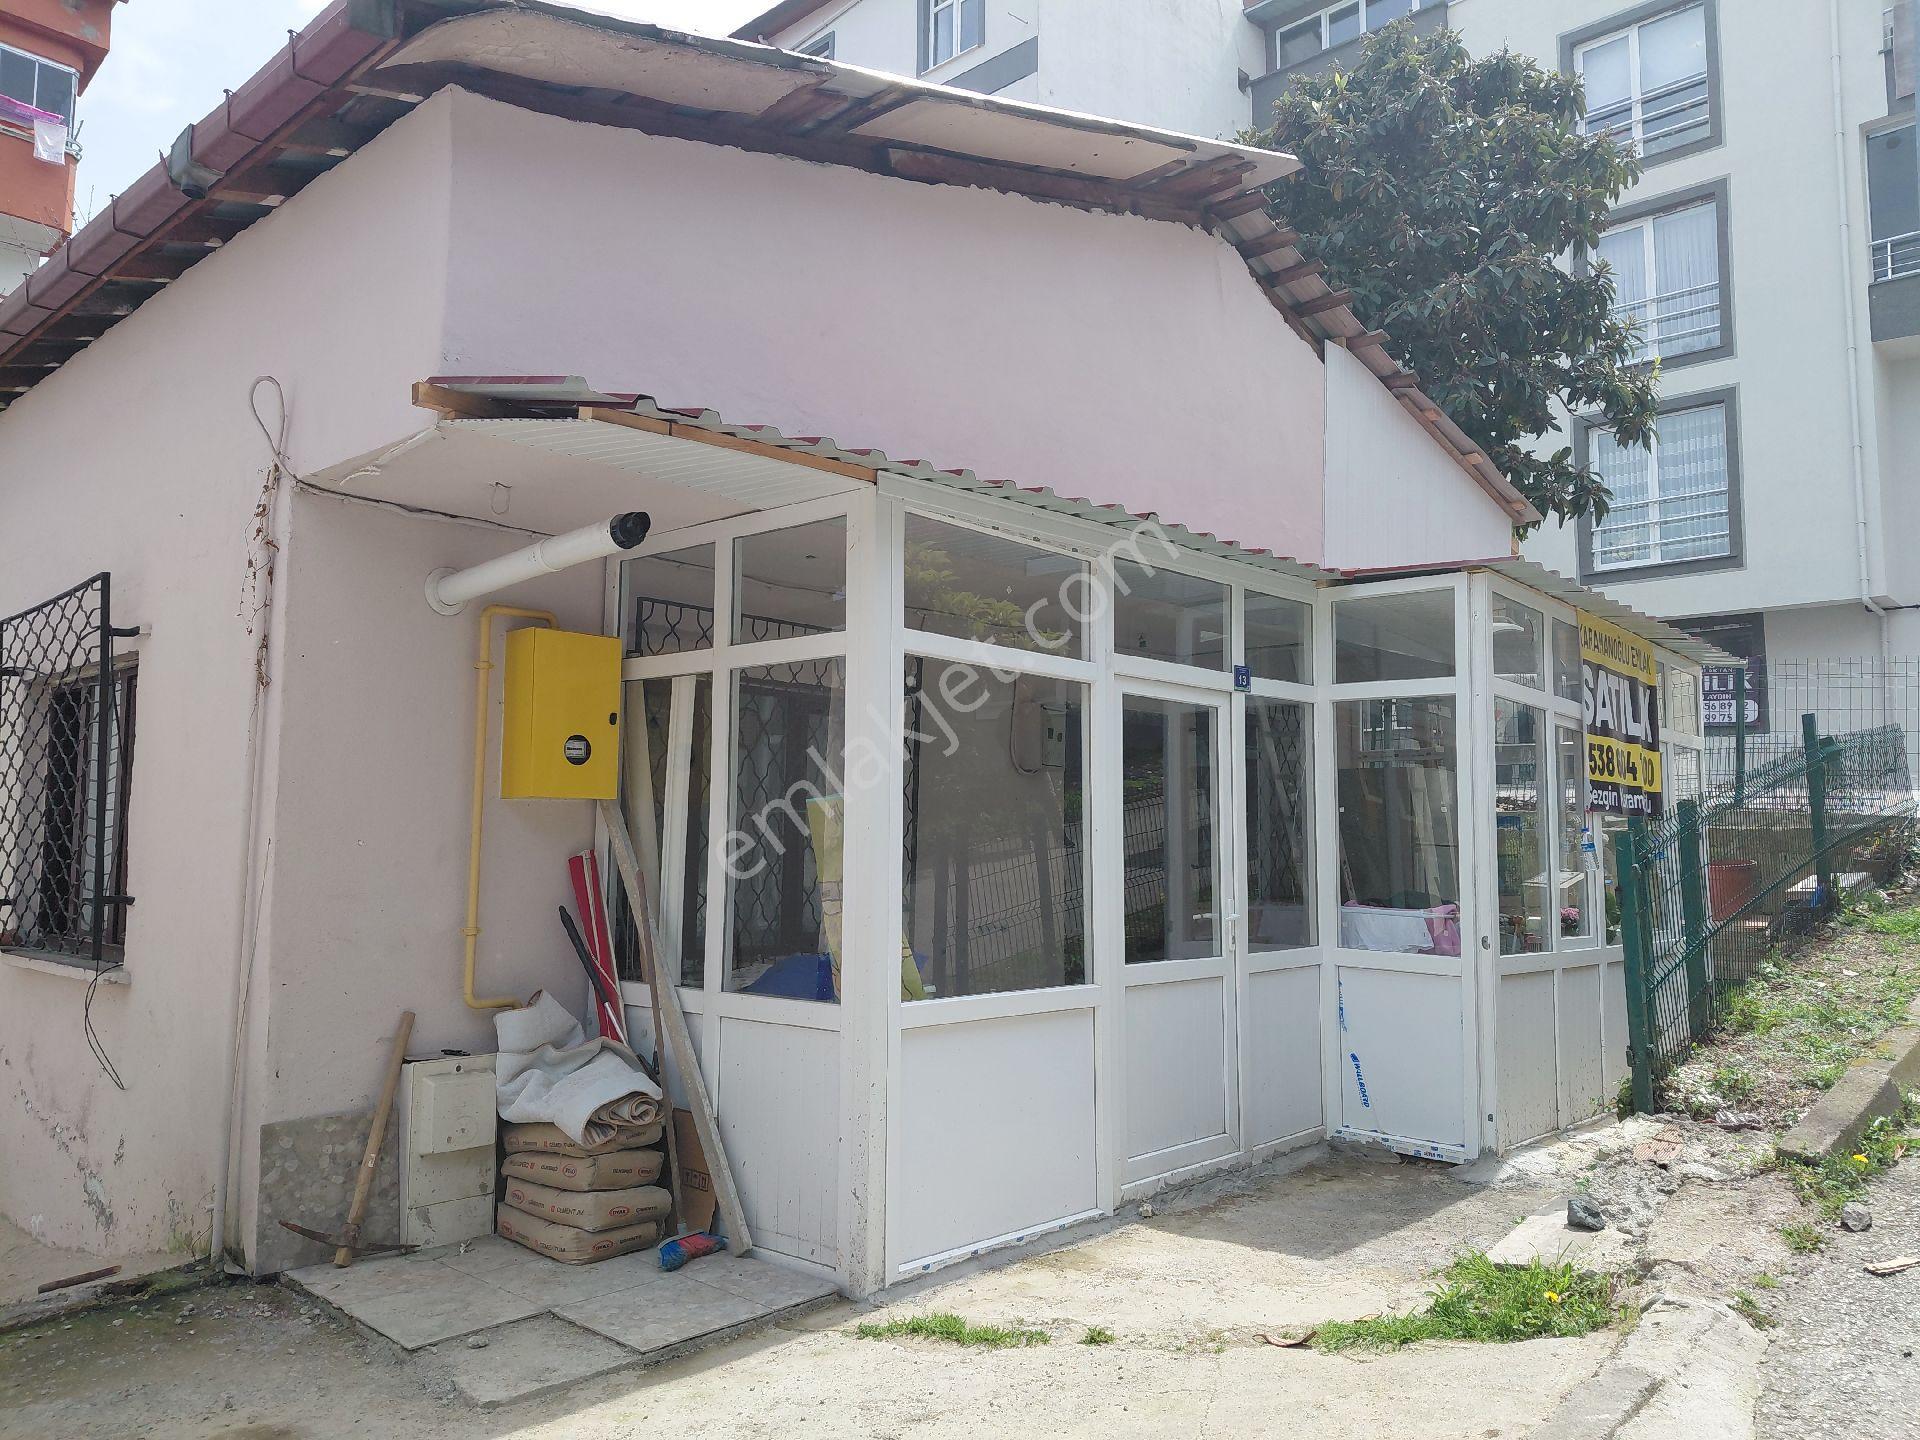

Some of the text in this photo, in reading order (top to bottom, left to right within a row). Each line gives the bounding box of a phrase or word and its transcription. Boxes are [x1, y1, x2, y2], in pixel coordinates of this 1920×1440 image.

[1238, 674, 1247, 686] 13
[1582, 664, 1653, 744] SATILK
[1588, 742, 1615, 778] 538
